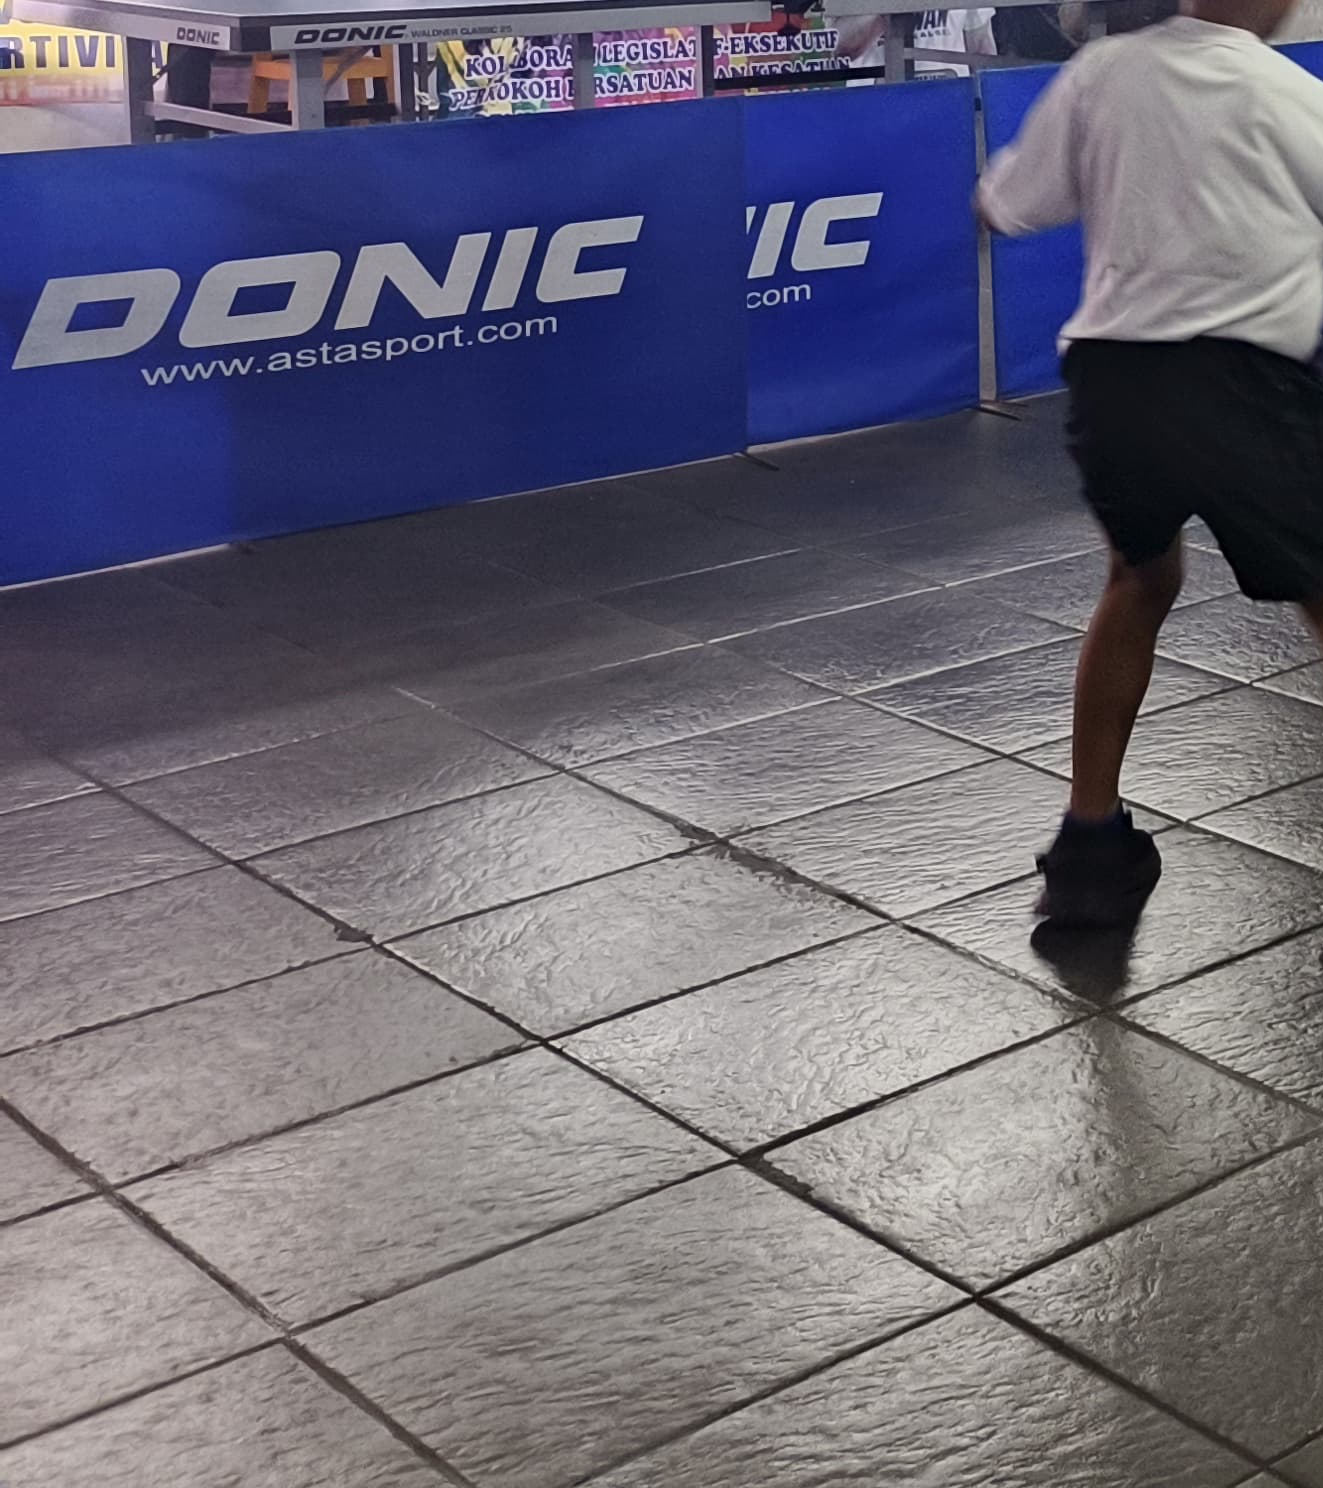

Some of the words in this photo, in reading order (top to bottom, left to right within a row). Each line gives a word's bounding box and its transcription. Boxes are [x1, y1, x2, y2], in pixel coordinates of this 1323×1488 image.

[176, 26, 220, 46] DONIC
[294, 24, 408, 45] DONIC
[11, 214, 645, 370] DONIC
[140, 316, 559, 386] www.astasport.com
